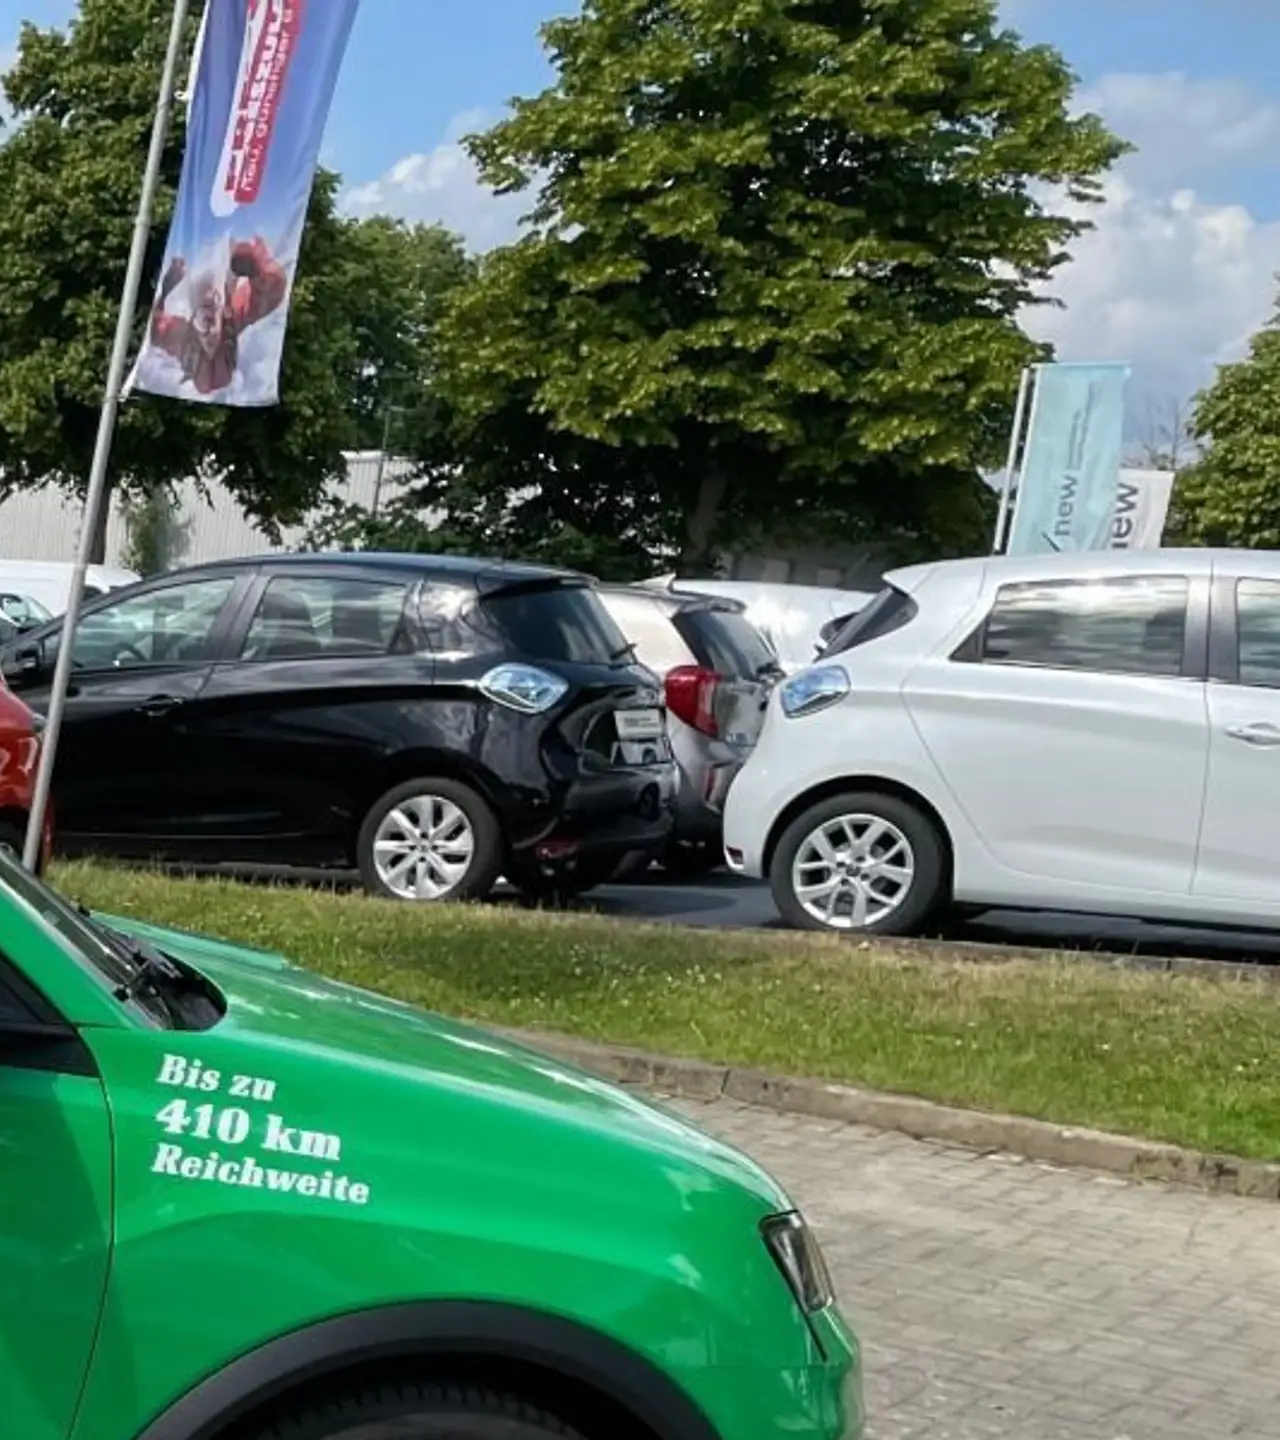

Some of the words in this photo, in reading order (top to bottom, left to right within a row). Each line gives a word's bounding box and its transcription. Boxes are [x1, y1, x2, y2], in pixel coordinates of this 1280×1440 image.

[1054, 475, 1078, 537] new
[155, 1053, 221, 1092] Bis
[228, 1074, 277, 1102] zu
[155, 1098, 250, 1145] 410
[260, 1113, 342, 1162] km
[150, 1142, 370, 1205] Reichweite
